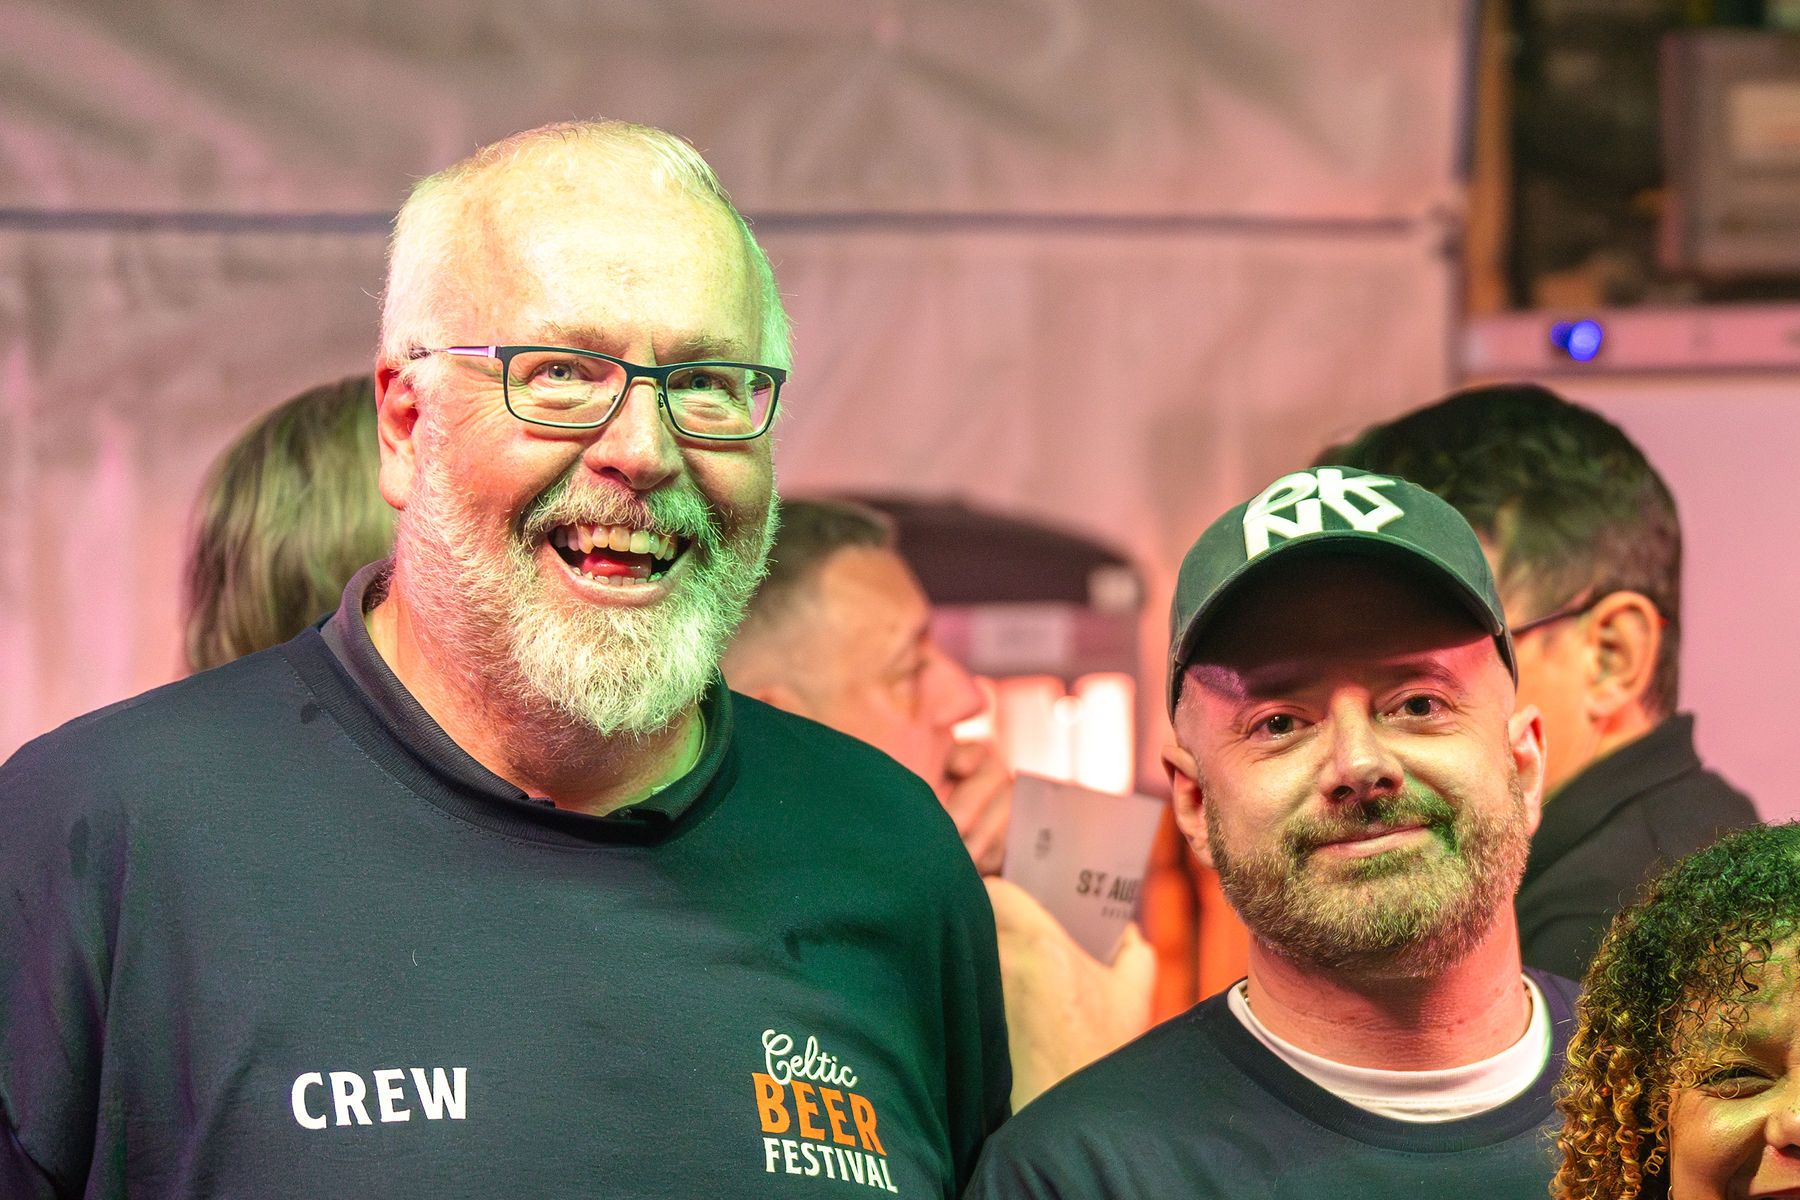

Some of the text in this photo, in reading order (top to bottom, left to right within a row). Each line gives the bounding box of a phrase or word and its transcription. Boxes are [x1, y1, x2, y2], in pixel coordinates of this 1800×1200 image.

[761, 1029, 858, 1088] Celtic
[291, 1067, 468, 1130] CREW
[751, 1072, 888, 1156] BEER
[762, 1136, 899, 1194] FESTIVAL
